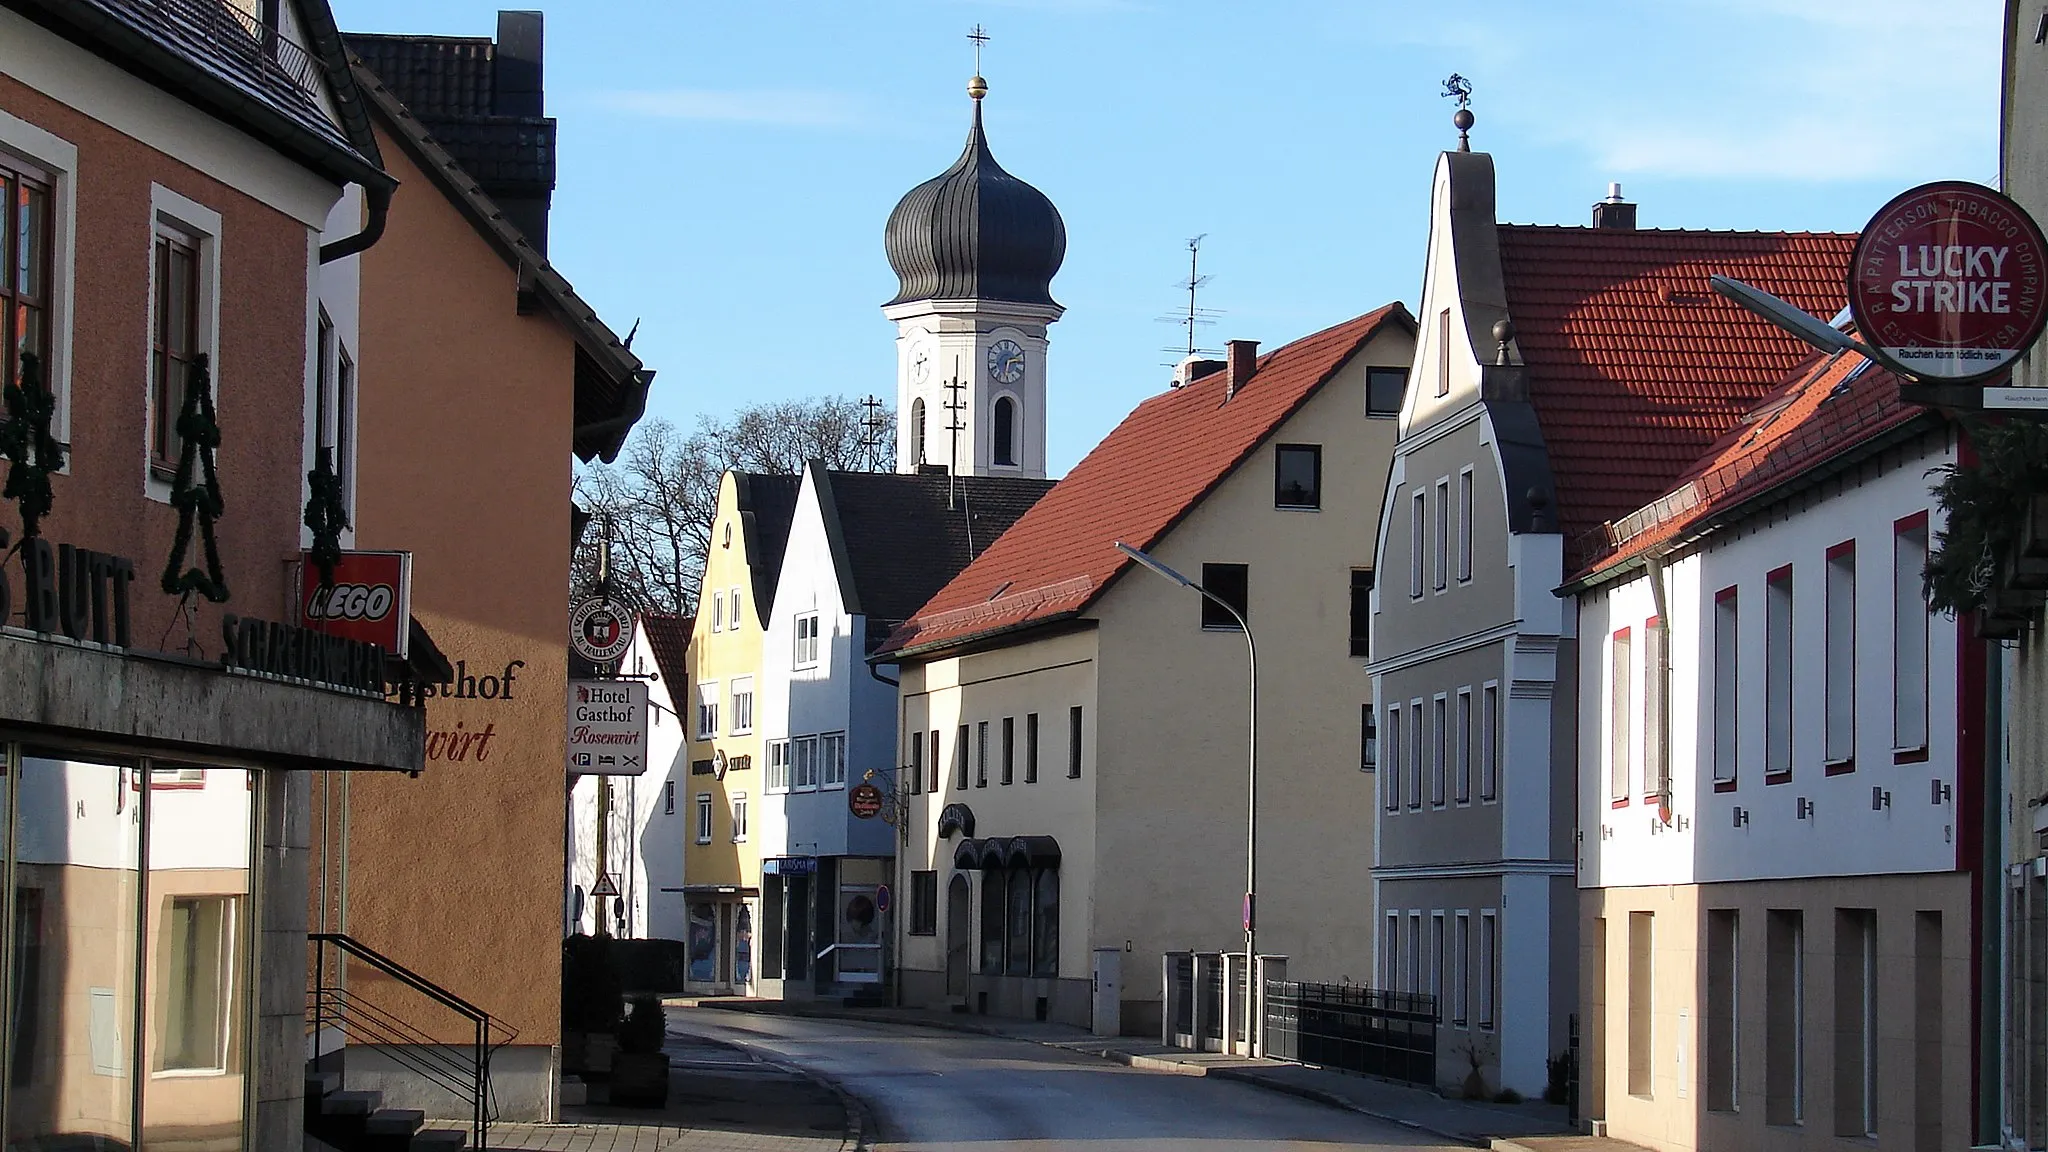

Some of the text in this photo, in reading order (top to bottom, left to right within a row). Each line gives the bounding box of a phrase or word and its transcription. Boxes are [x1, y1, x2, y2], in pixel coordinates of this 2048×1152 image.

[1867, 201, 1937, 277] PATTERSON
[1947, 199, 2018, 239] TOBACCO
[2015, 242, 2038, 319] COMPANY
[1898, 245, 2009, 278] LUCKY
[1891, 279, 2011, 314] STRIKE
[1898, 348, 2002, 361] Rauchen kann tödlich sein
[22, 536, 135, 648] BUTT
[574, 602, 602, 627] SCHLOSS
[222, 613, 387, 695] SCHREIBWAREN
[590, 687, 631, 703] Hotel
[576, 706, 636, 722] Gasthof
[570, 724, 640, 745] Rosenwirt
